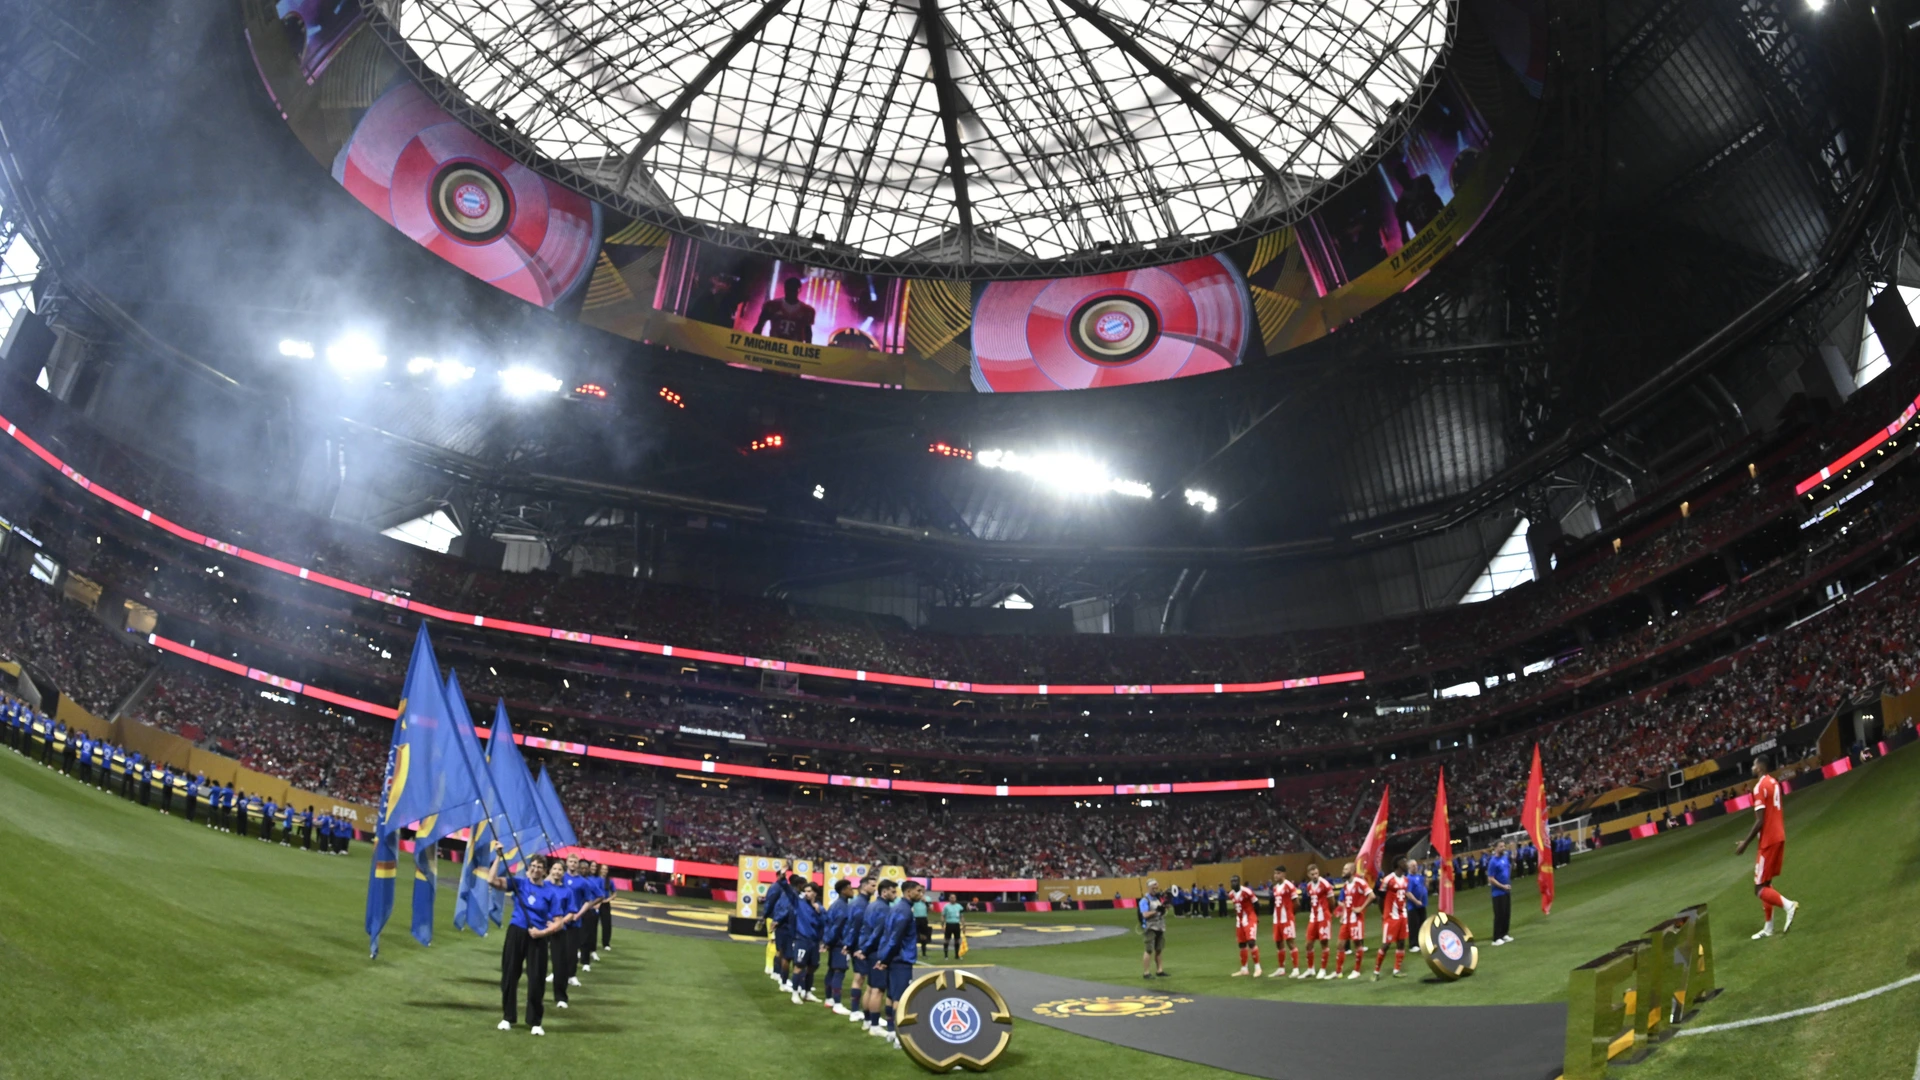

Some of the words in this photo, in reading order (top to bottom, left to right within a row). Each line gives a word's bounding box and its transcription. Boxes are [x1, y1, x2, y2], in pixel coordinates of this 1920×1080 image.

[730, 333, 742, 345] 17
[744, 335, 788, 355] MICHAEL
[793, 344, 821, 359] OLISE
[1773, 783, 1781, 811] 4
[332, 805, 358, 821] FIFA
[1077, 885, 1102, 896] FIFA
[797, 949, 806, 963] 17
[937, 1000, 970, 1012] PARIS
